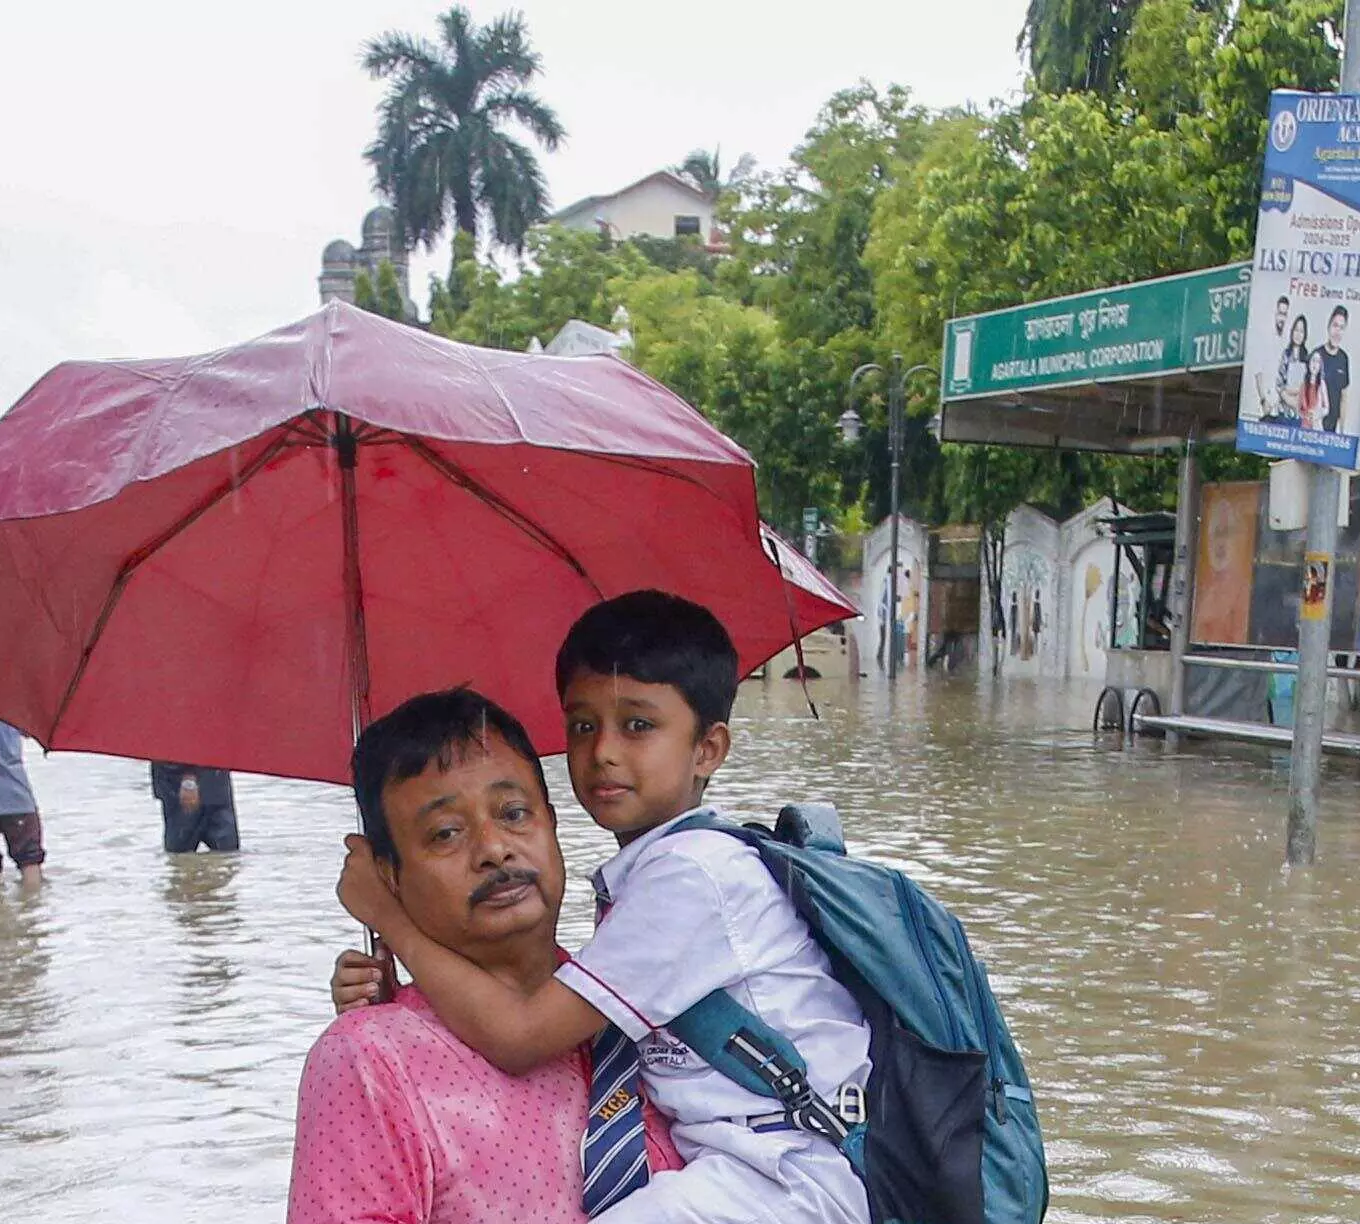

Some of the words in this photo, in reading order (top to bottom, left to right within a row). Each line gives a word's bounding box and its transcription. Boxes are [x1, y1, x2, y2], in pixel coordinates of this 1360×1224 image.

[1291, 213, 1344, 231] Admissions
[1259, 248, 1288, 271] IAS
[1297, 250, 1333, 275] TCS
[1290, 277, 1318, 297] Free
[1321, 285, 1344, 300] Demo
[991, 358, 1038, 381] AGARTALA
[1039, 350, 1087, 376] MUNICIPAL
[1090, 339, 1163, 369] CORPORATION
[599, 1088, 629, 1119] HCS
